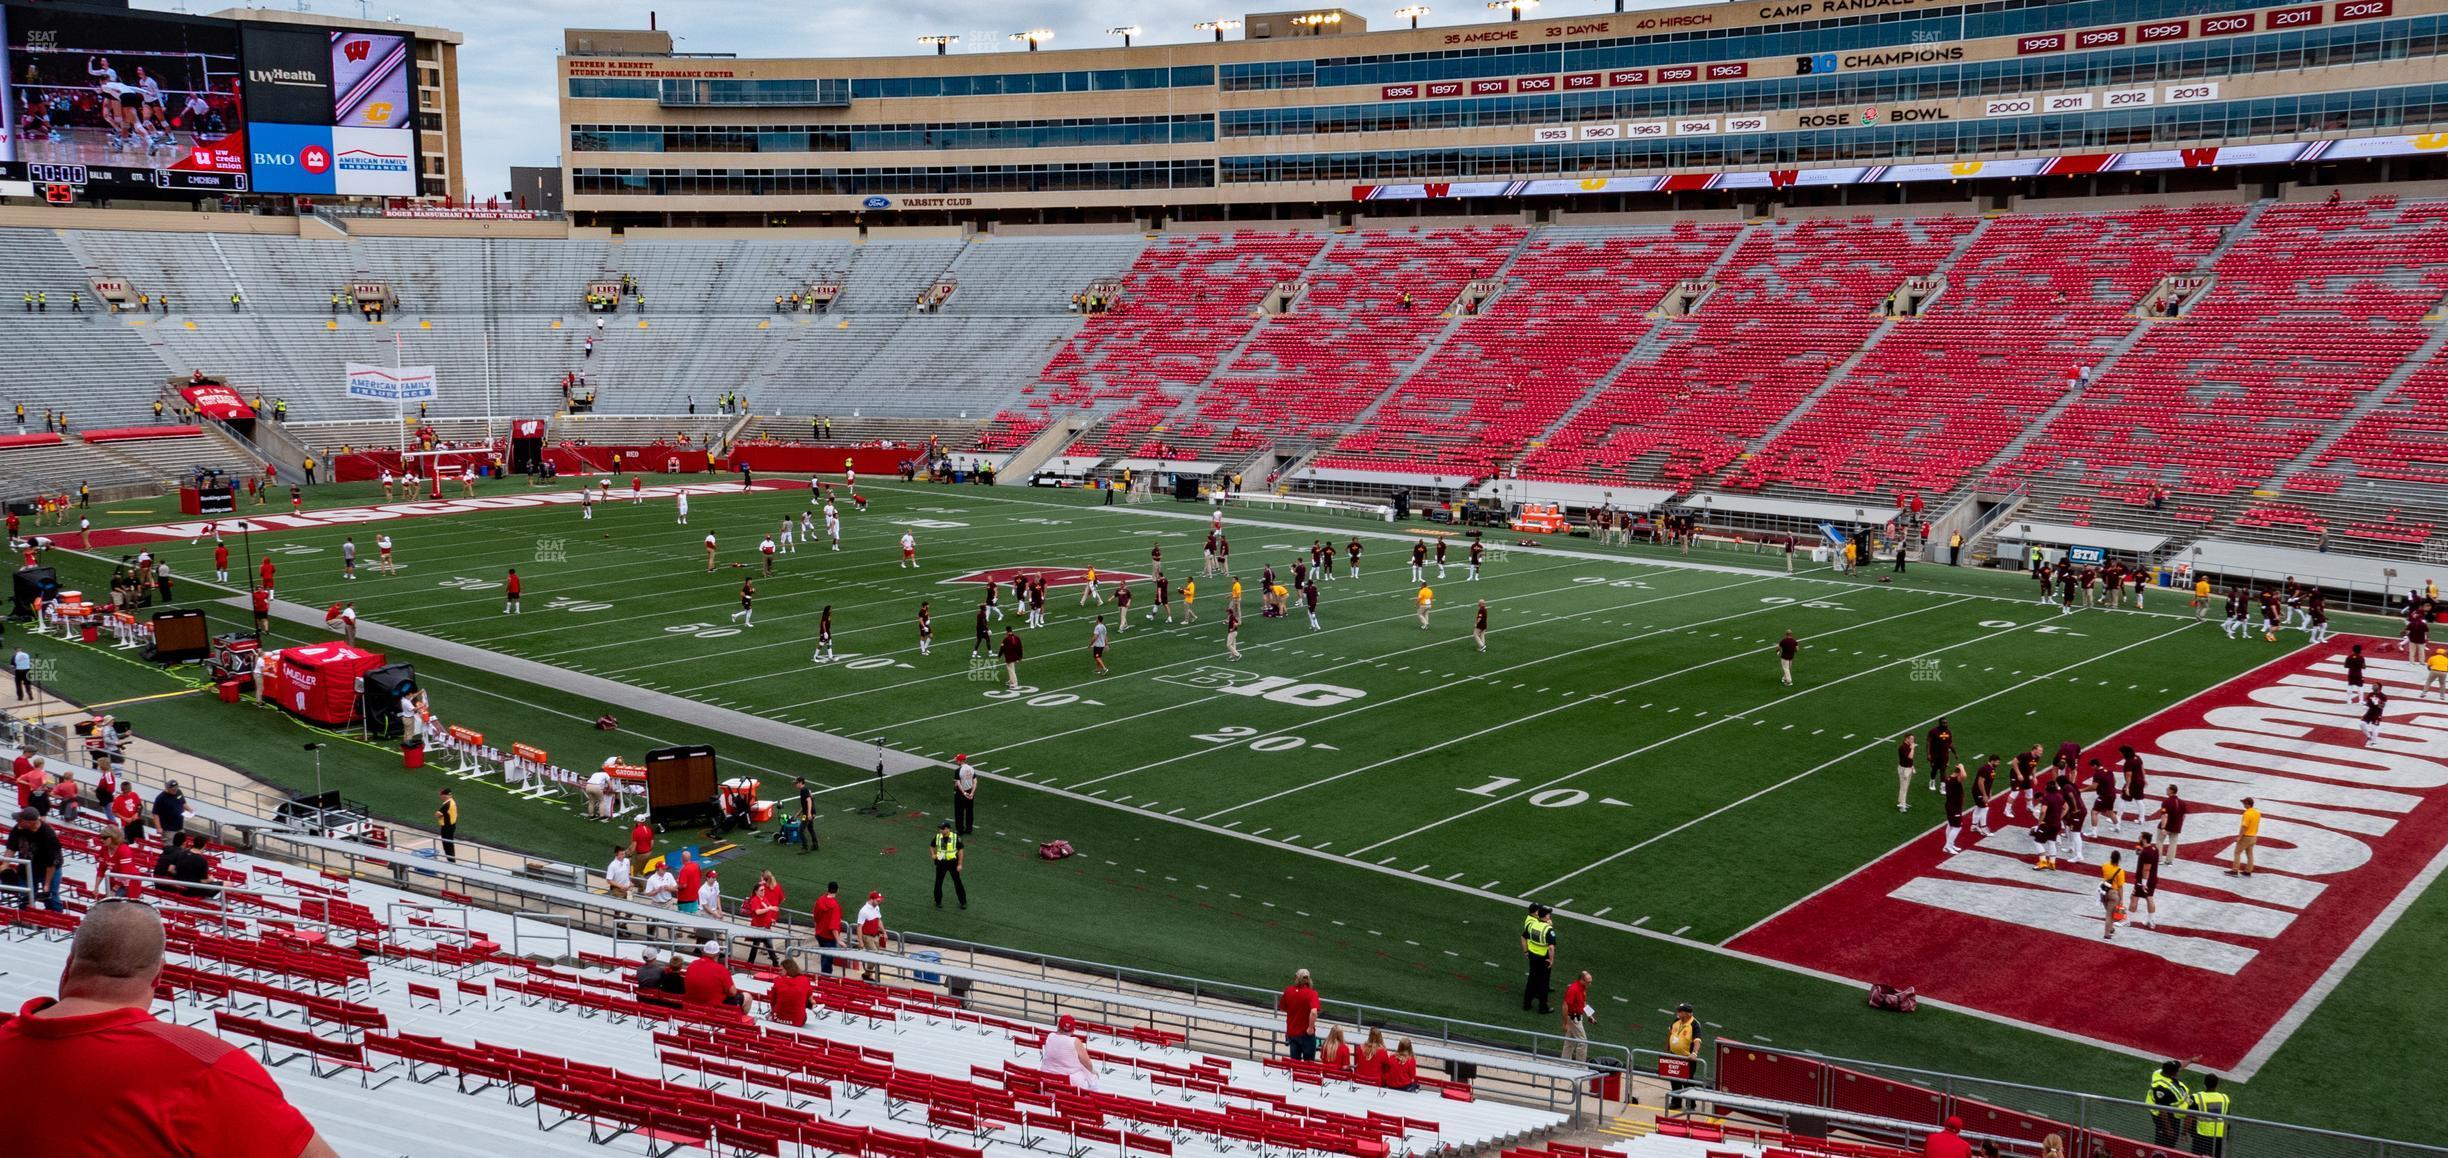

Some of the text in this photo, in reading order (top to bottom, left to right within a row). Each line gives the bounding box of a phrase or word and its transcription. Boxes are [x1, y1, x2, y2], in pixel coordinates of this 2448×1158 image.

[1759, 0, 1913, 19] CAMP RANDA
[2343, 3, 2384, 17] 2012
[1636, 14, 1713, 29] 40 HIRSCH
[2276, 10, 2312, 24] 2011
[1545, 22, 1609, 37] 33 DAYNE
[2206, 17, 2248, 31] 2010
[1444, 30, 1519, 44] 35 AMECHE
[2082, 31, 2119, 44] 1998
[2143, 25, 2182, 38] 1999
[2023, 37, 2059, 50] 1993
[344, 40, 371, 63] W
[1844, 47, 1964, 68] CHAMPIONS
[608, 61, 617, 69] M.
[618, 61, 654, 69] BENNETT
[1711, 64, 1743, 77] 1962
[570, 69, 642, 77] STUDENT-ATHLETE
[645, 70, 701, 78] PERFORMANCE
[1615, 72, 1643, 83] 1952
[1662, 68, 1692, 81] 1959
[1477, 82, 1503, 92] 1901
[1521, 79, 1550, 89] 1906
[1570, 76, 1595, 86] 1912
[1386, 87, 1413, 97] 1896
[1431, 84, 1457, 94] 1897
[2174, 86, 2210, 99] 2013
[2053, 96, 2083, 109] 2011
[2111, 92, 2146, 105] 2012
[1989, 101, 2031, 113] 2000
[1799, 107, 1949, 127] ROSE BOWL
[1633, 124, 1661, 135] 1963
[1682, 122, 1711, 133] 1994
[1731, 118, 1761, 130] 1999
[1540, 129, 1567, 140] 1953
[1585, 127, 1615, 138] 1960
[215, 155, 241, 163] credit
[254, 152, 295, 165] BMO
[339, 157, 378, 165] AMERICAN
[2179, 147, 2220, 168] W
[31, 164, 83, 182] 90:00
[1769, 170, 1799, 188] W
[162, 175, 170, 187] 3
[234, 175, 245, 189] 0
[47, 185, 70, 202] 25
[1424, 183, 1451, 198] W
[902, 198, 972, 207] VARSITY CLUB
[351, 379, 430, 390] AMERICAN FAMILY
[522, 421, 538, 435] W
[122, 483, 750, 538] WISCONSIN
[2072, 548, 2100, 561] BTN
[286, 667, 317, 686] MUELLER
[983, 686, 1080, 706] 30
[1190, 726, 1306, 752] 20
[615, 769, 646, 777] GATORADE
[1456, 776, 1590, 808] 10
[1660, 1058, 1689, 1066] EMERGENCY
